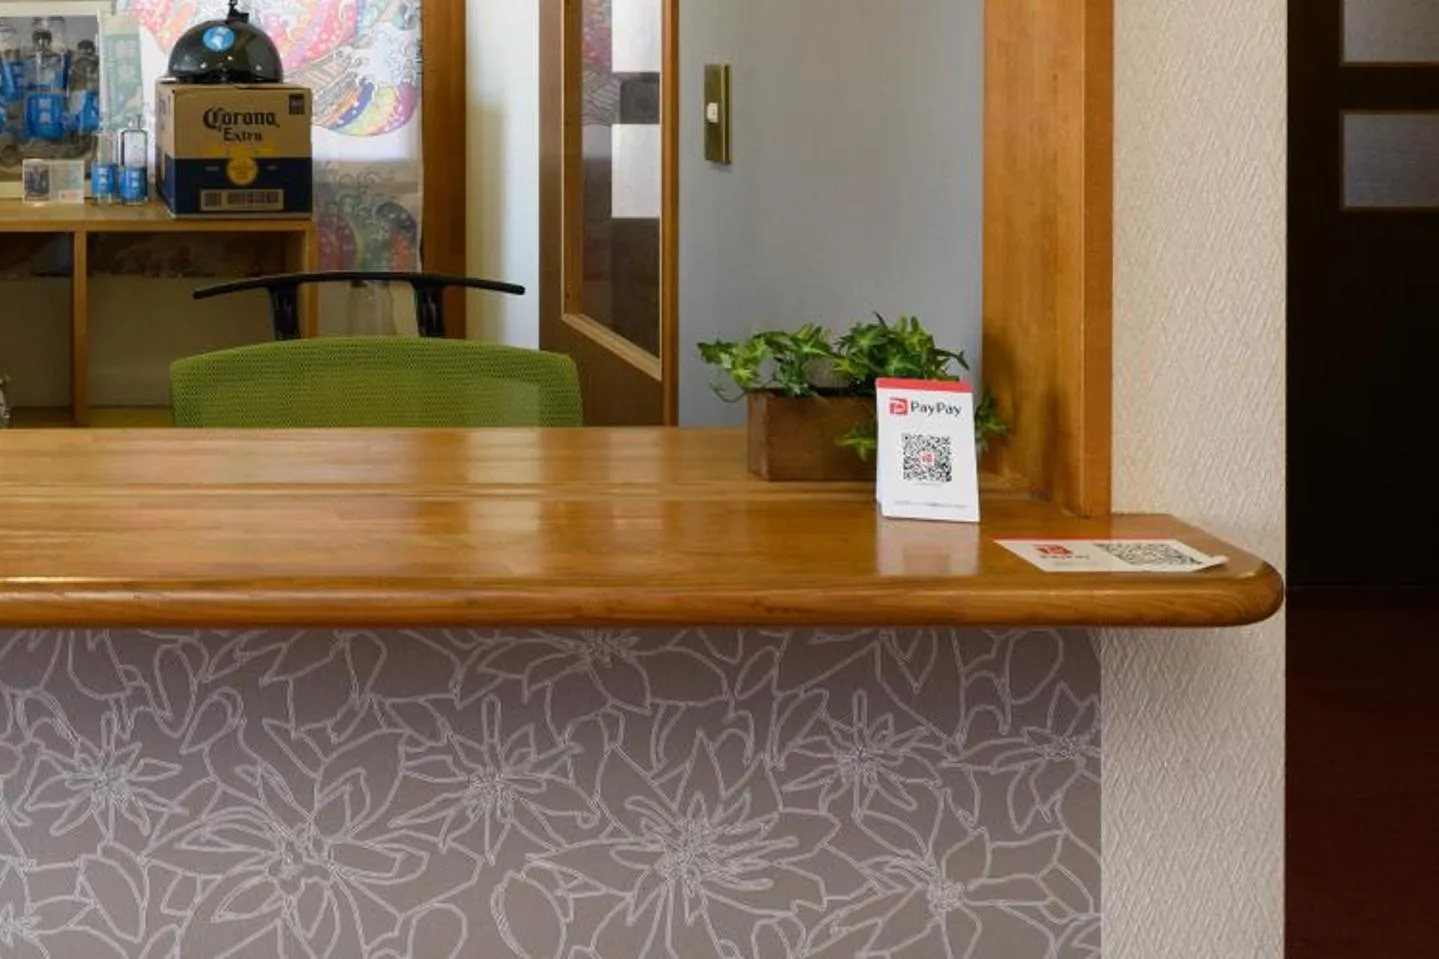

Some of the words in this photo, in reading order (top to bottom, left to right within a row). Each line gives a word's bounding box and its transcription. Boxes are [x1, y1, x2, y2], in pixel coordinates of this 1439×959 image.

[202, 107, 281, 133] Corona
[223, 127, 263, 143] Extra
[910, 399, 963, 418] PayPay
